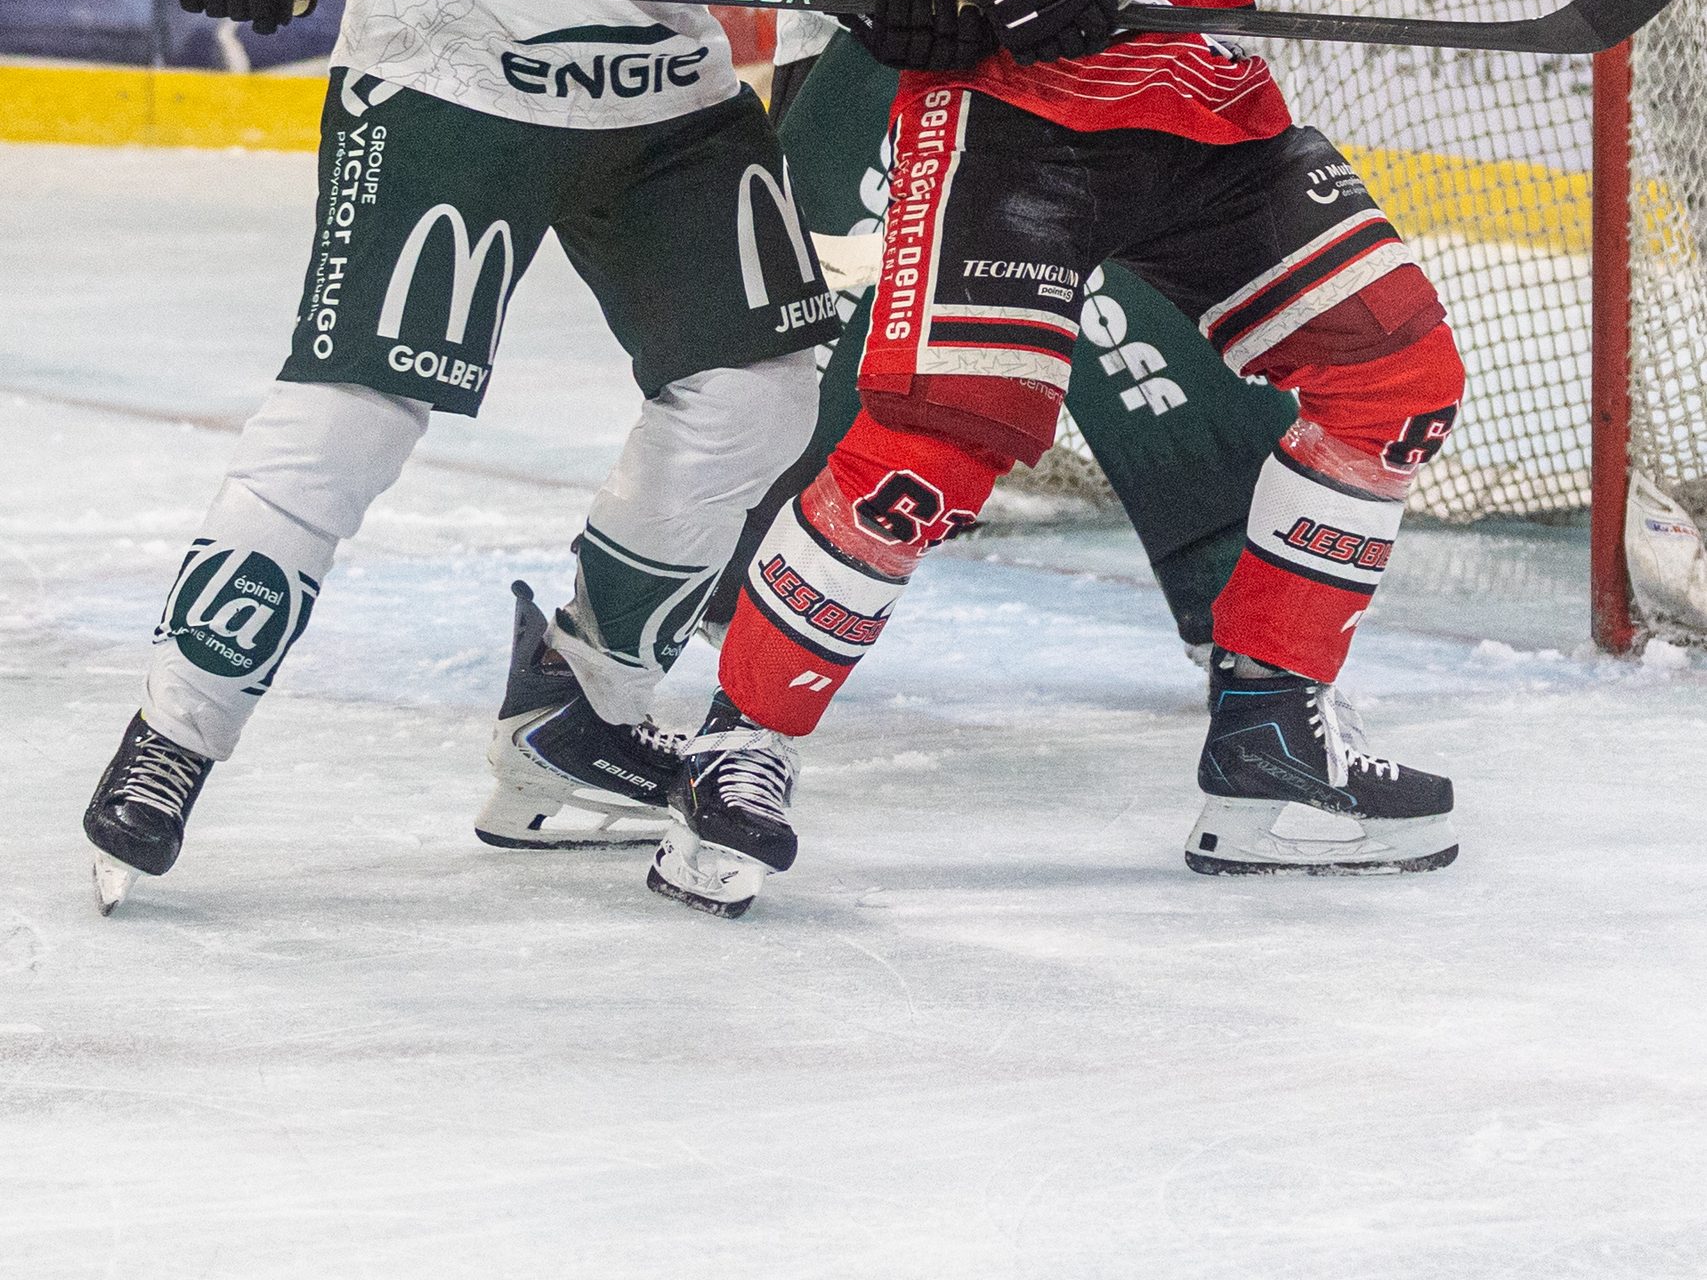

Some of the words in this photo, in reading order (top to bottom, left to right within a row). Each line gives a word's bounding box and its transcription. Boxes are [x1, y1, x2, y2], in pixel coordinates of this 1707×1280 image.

[326, 131, 346, 226] prévoyance
[361, 125, 388, 205] GROUPE
[321, 230, 331, 248] et
[962, 260, 1080, 289] TECHNIGUM
[313, 257, 349, 360] HUGO
[388, 344, 490, 394] GOLBEY
[1287, 520, 1362, 562] LES
[233, 574, 285, 606] épinal
[762, 556, 820, 613] LES
[205, 633, 253, 669] image
[592, 758, 658, 792] BAUER
